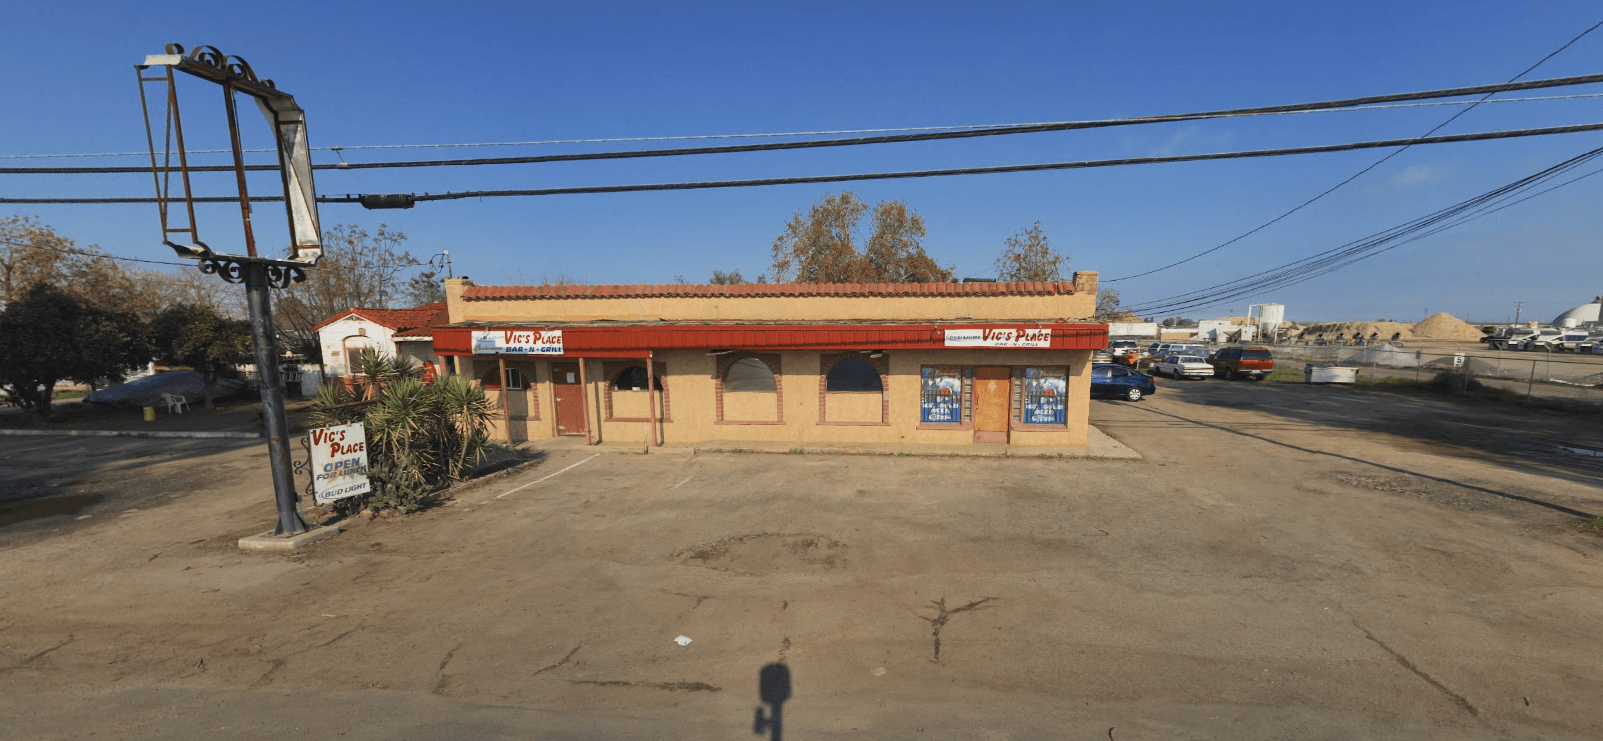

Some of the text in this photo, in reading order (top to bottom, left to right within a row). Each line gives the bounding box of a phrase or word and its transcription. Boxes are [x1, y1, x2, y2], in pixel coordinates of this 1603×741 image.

[533, 330, 561, 344] PLACE
[1015, 328, 1050, 342] PLACE
[329, 442, 364, 458] PLACE
[323, 457, 361, 472] OPEN
[316, 464, 367, 481] FOR LUNCH
[325, 482, 367, 498] BUD LIGHT
